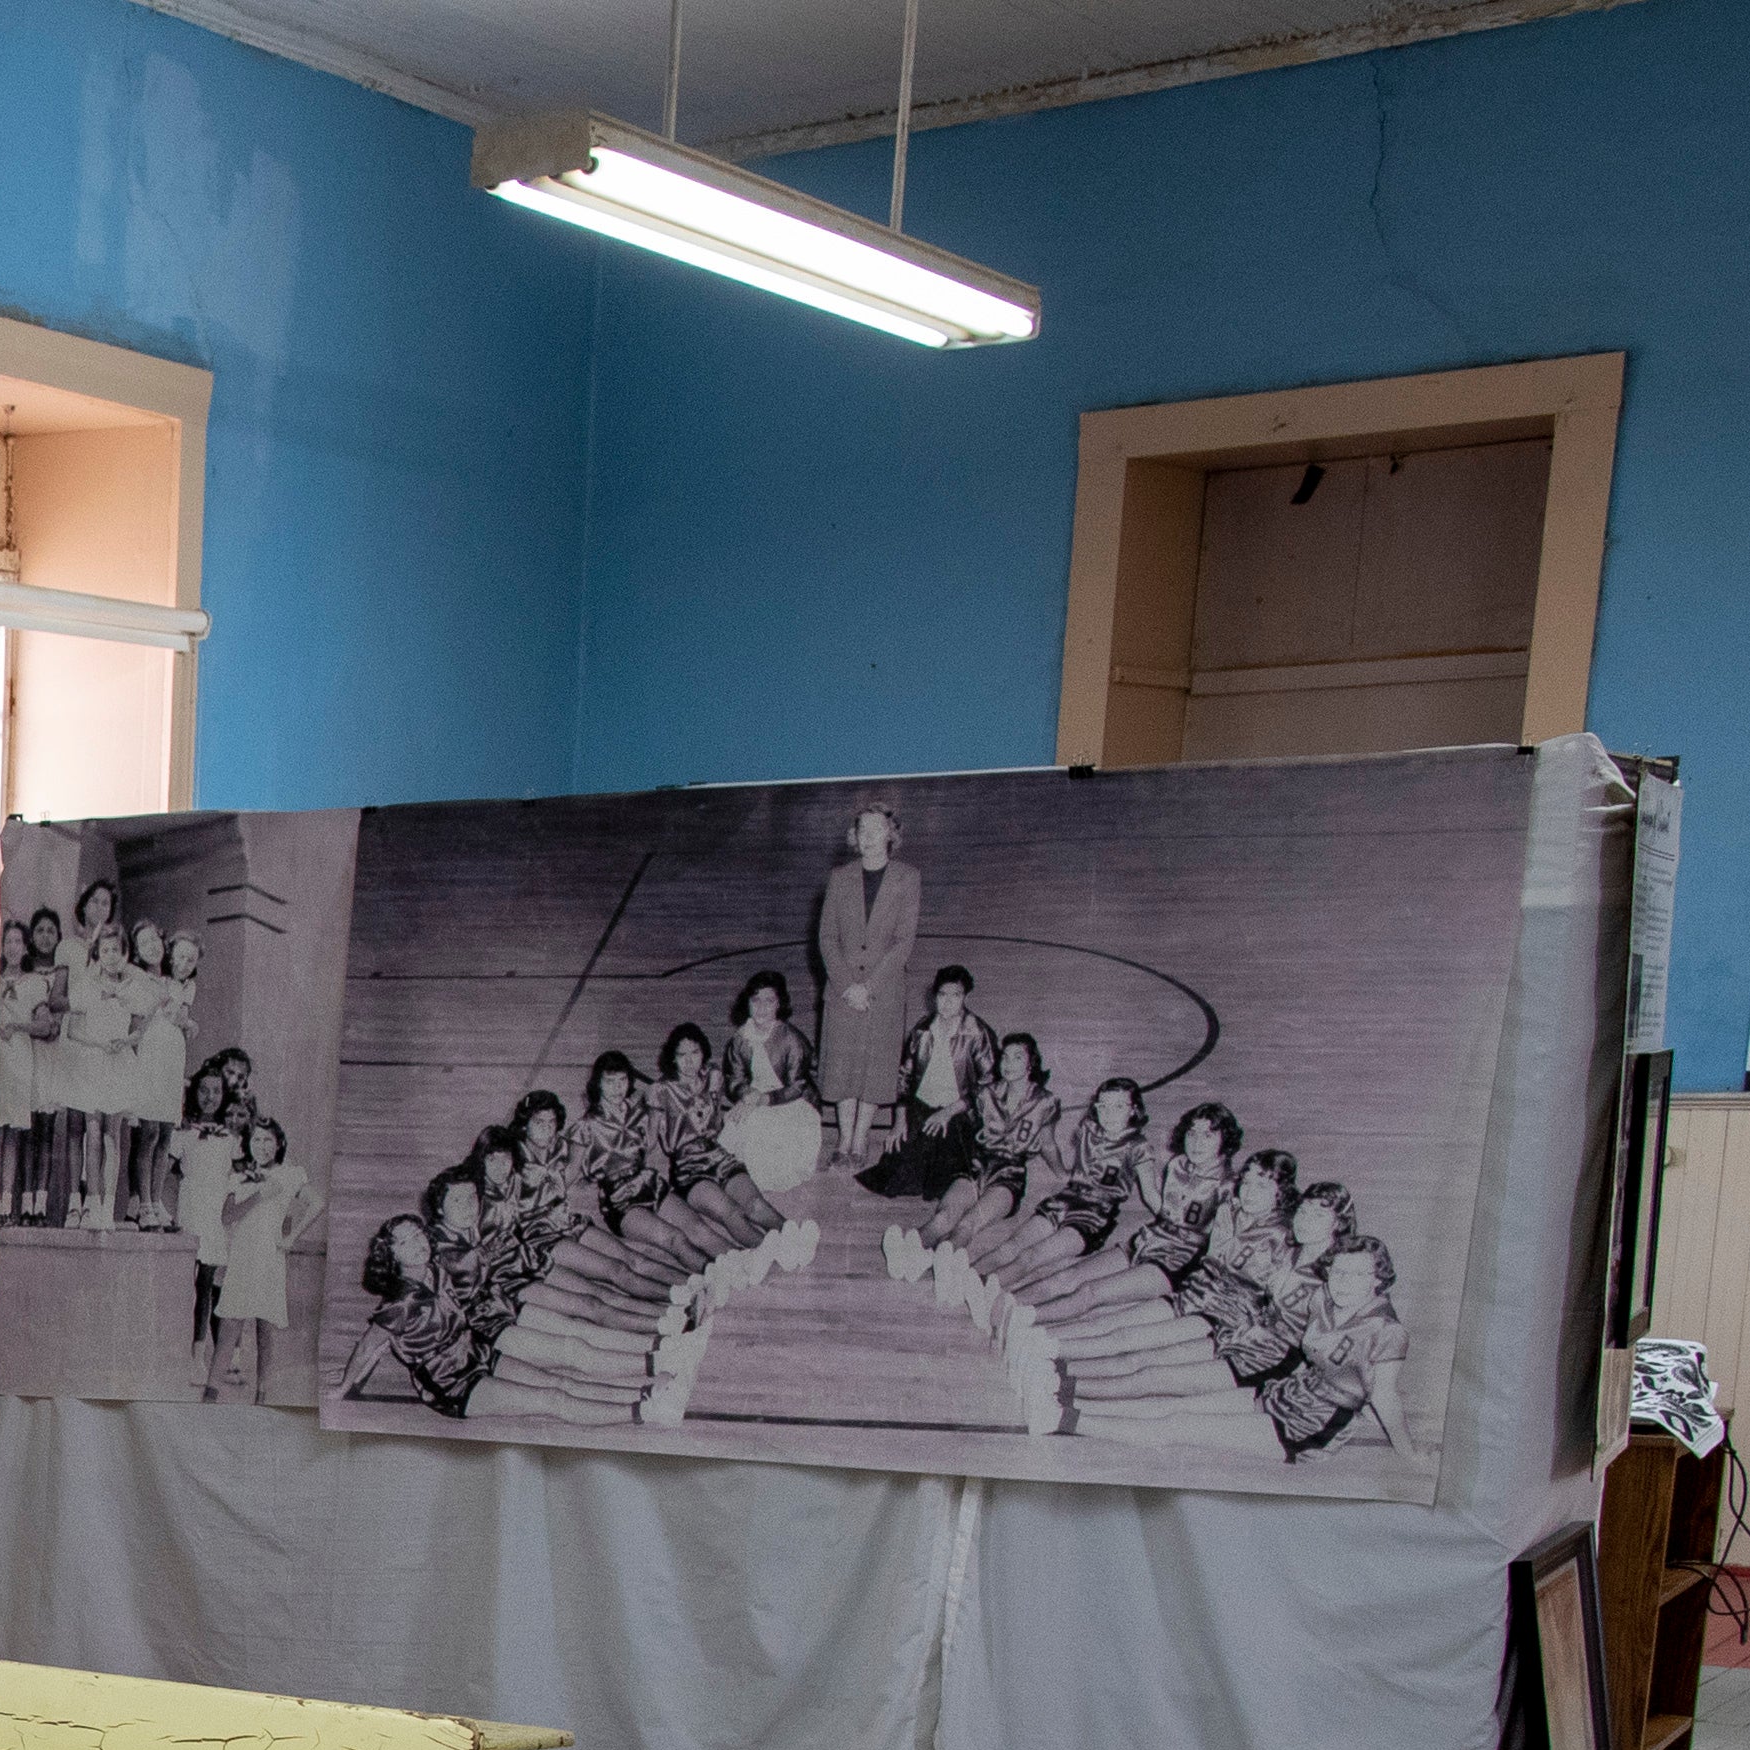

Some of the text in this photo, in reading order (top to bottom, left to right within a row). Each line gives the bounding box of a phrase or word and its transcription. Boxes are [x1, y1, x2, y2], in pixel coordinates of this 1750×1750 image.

[1017, 1119, 1033, 1143] B
[1185, 1201, 1202, 1225] B
[1232, 1245, 1254, 1270] B
[1328, 1335, 1353, 1366] B
